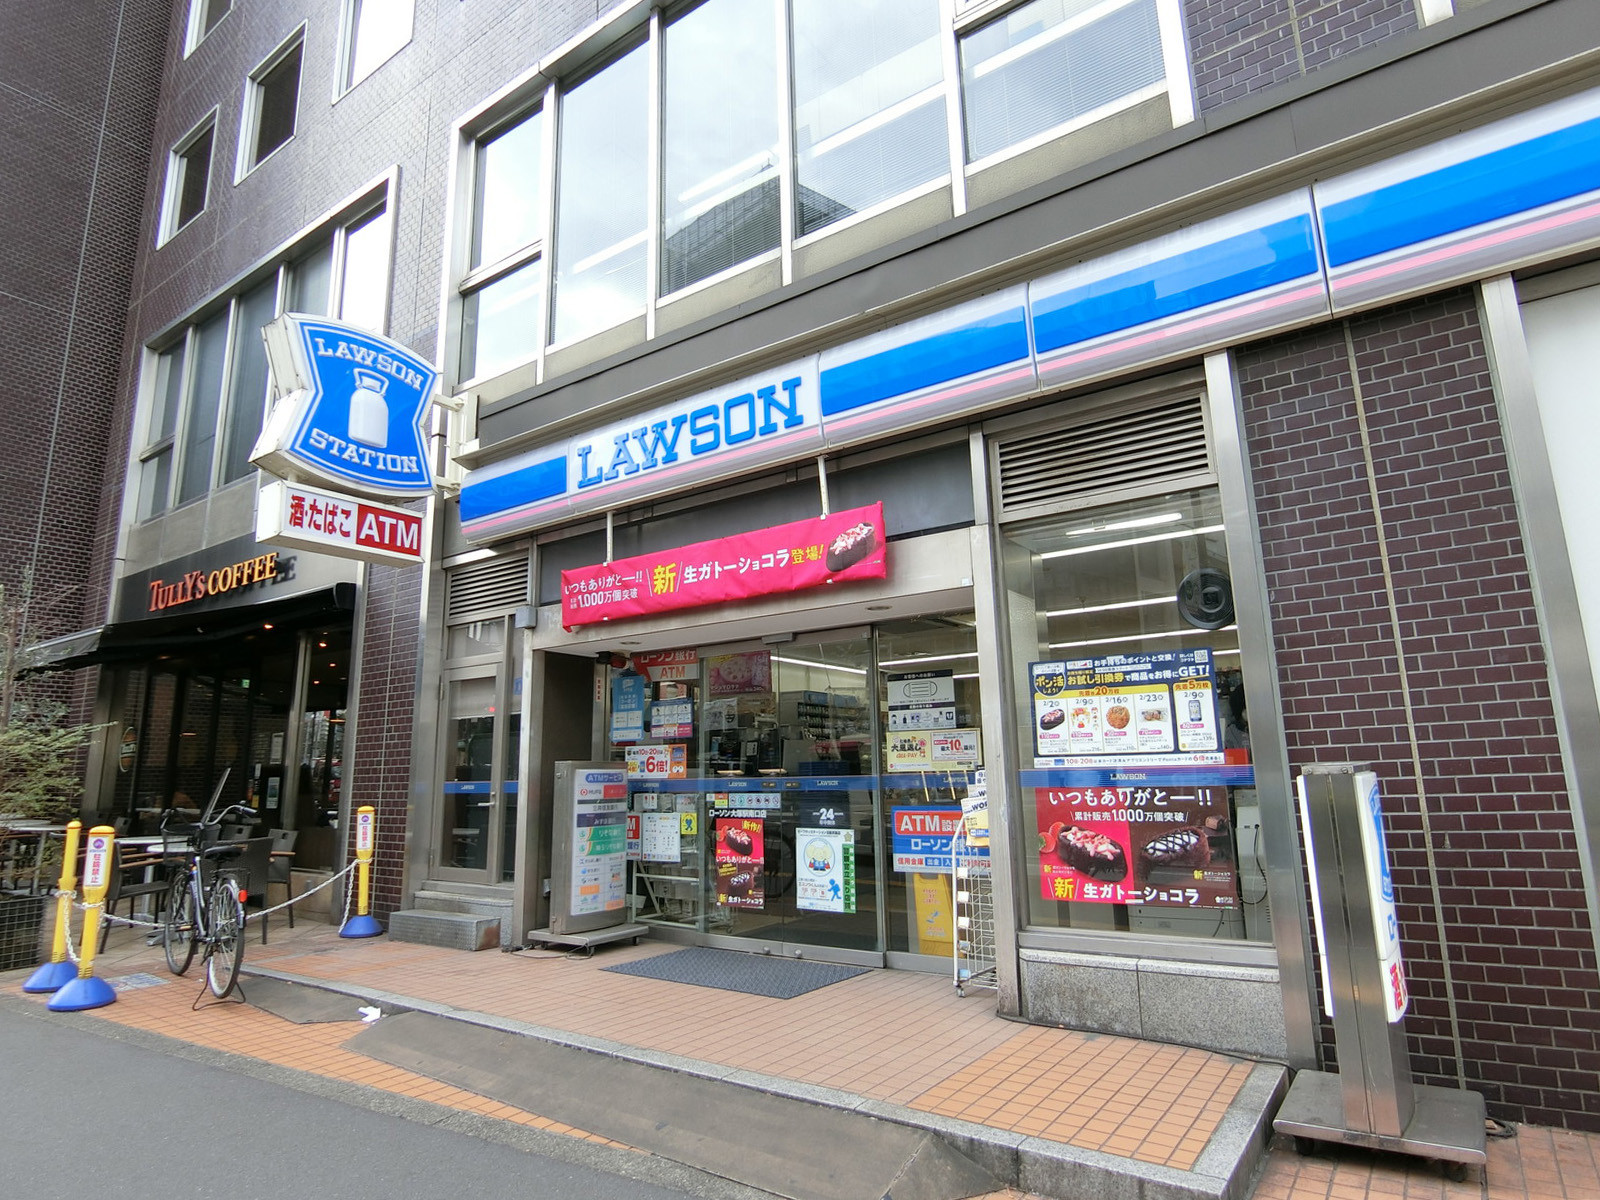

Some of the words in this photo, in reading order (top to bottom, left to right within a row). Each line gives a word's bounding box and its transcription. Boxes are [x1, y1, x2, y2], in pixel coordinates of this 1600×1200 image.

[315, 337, 424, 391] LAWSON
[577, 376, 804, 489] LAWSON
[309, 427, 420, 474] STATION
[359, 513, 419, 550] ATM
[207, 552, 279, 596] COFFEE
[653, 561, 677, 595] 新
[660, 666, 686, 679] ATM
[1110, 773, 1146, 781] LAWSON
[819, 807, 835, 820] 24
[1054, 877, 1074, 899] 新
[1084, 883, 1199, 904] 生ガトーショコラ
